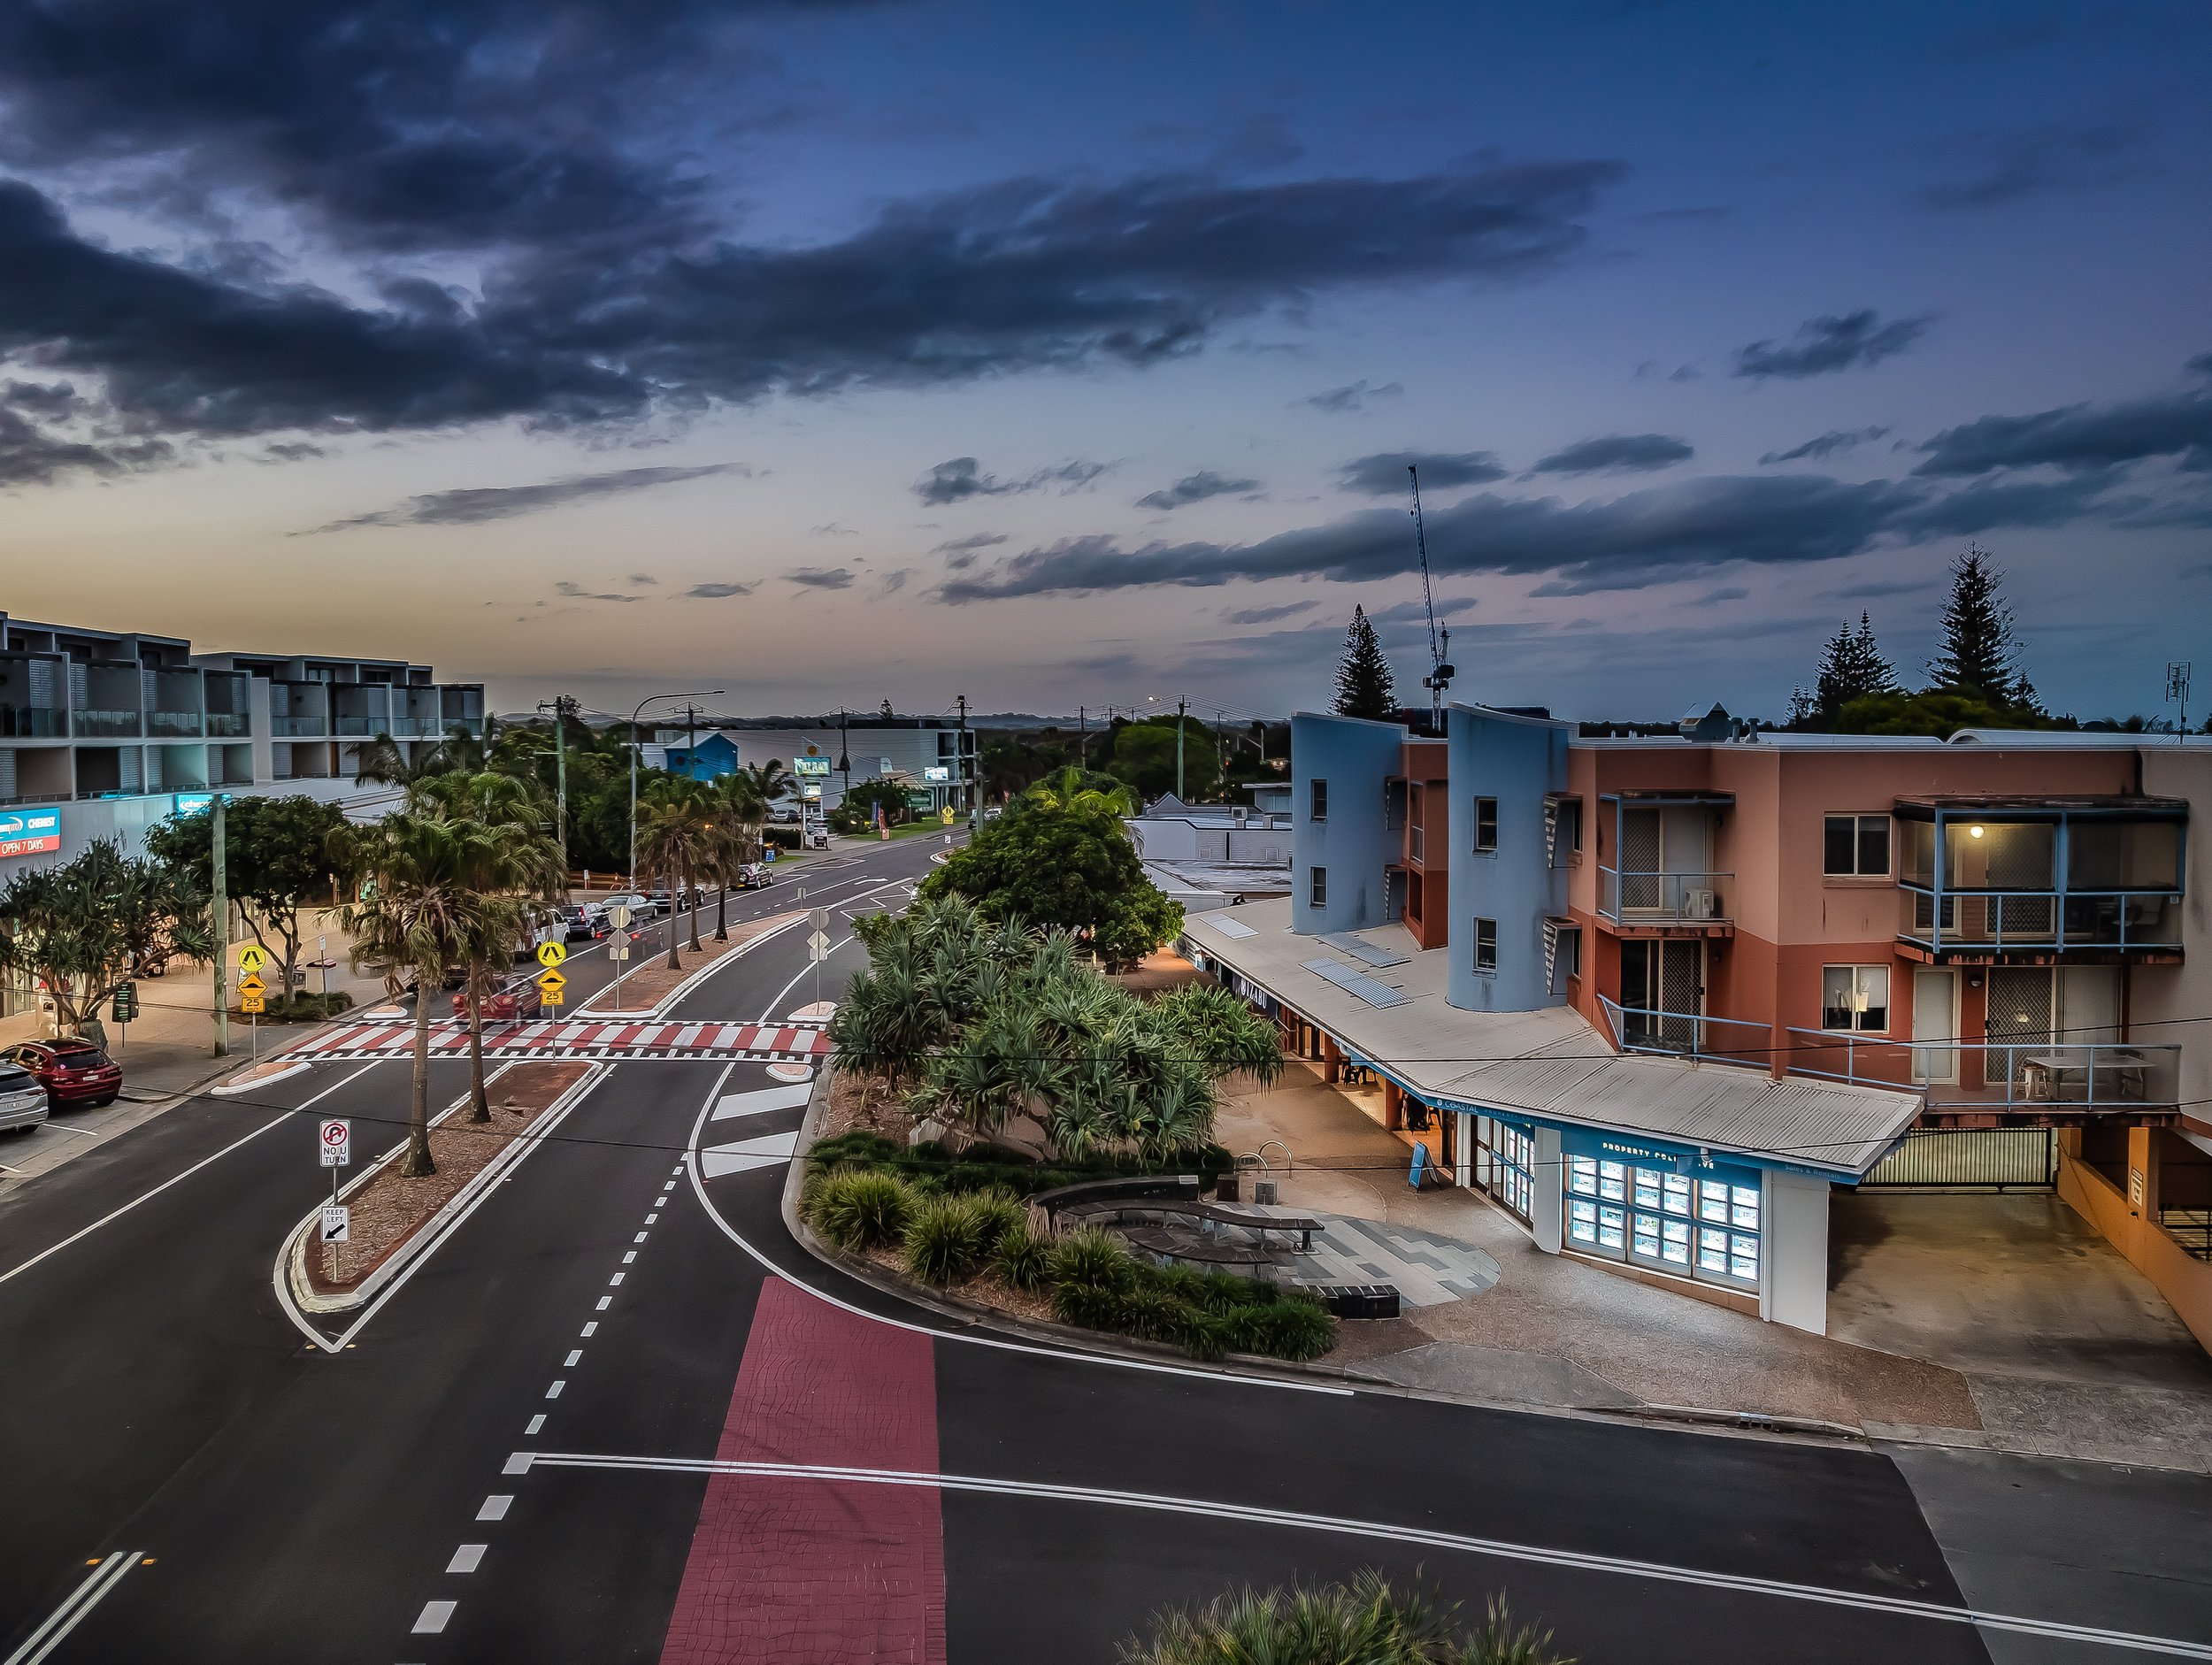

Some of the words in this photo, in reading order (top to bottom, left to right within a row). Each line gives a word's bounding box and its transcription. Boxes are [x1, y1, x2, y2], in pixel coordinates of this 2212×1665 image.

[28, 817, 56, 829] CHEMIST
[2, 842, 20, 855] OPEN
[21, 841, 27, 851] 7
[27, 839, 44, 851] DAYS
[546, 992, 559, 1001] 25
[1445, 1101, 1479, 1113] COASTAL
[323, 1147, 337, 1155] NO
[1602, 1142, 1650, 1157] PROPERTY
[324, 1155, 346, 1164] TURN
[1785, 1164, 1804, 1173] Sales
[1813, 1169, 1841, 1179] Rentals
